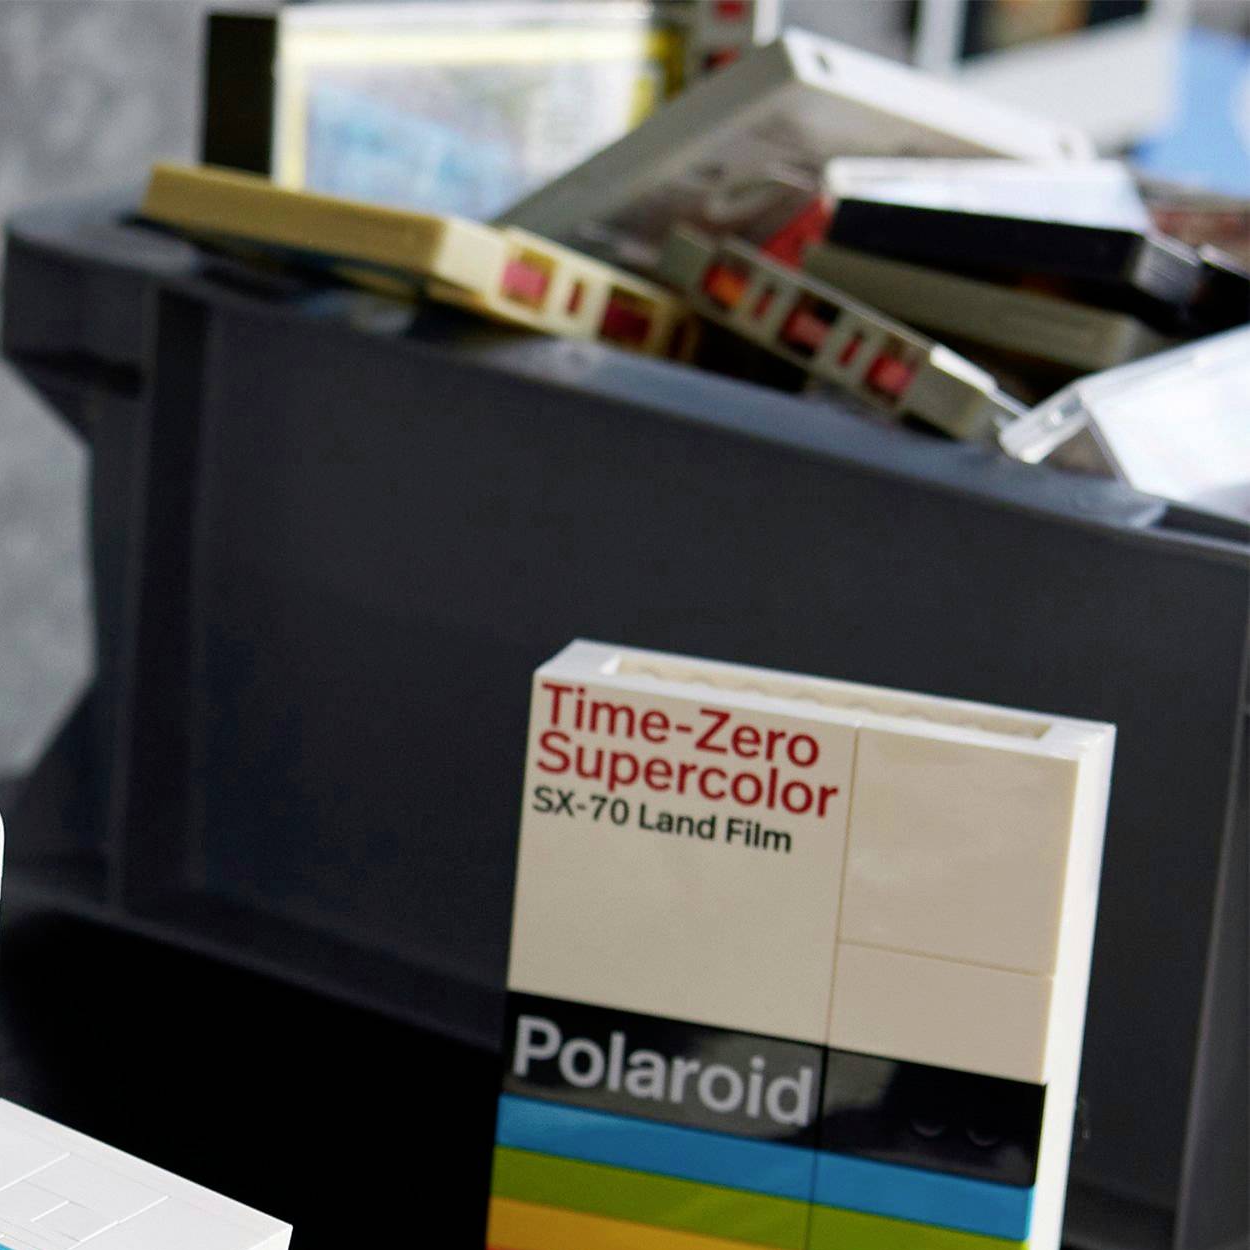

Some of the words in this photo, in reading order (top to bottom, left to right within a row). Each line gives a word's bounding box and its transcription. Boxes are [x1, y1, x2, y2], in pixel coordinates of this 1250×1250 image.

[541, 681, 820, 768] Time-Zero
[536, 729, 839, 818] Supercolor
[532, 785, 630, 826] SX-70
[638, 803, 717, 840] Land
[726, 817, 792, 854] Film
[512, 1014, 813, 1128] Polaroid
